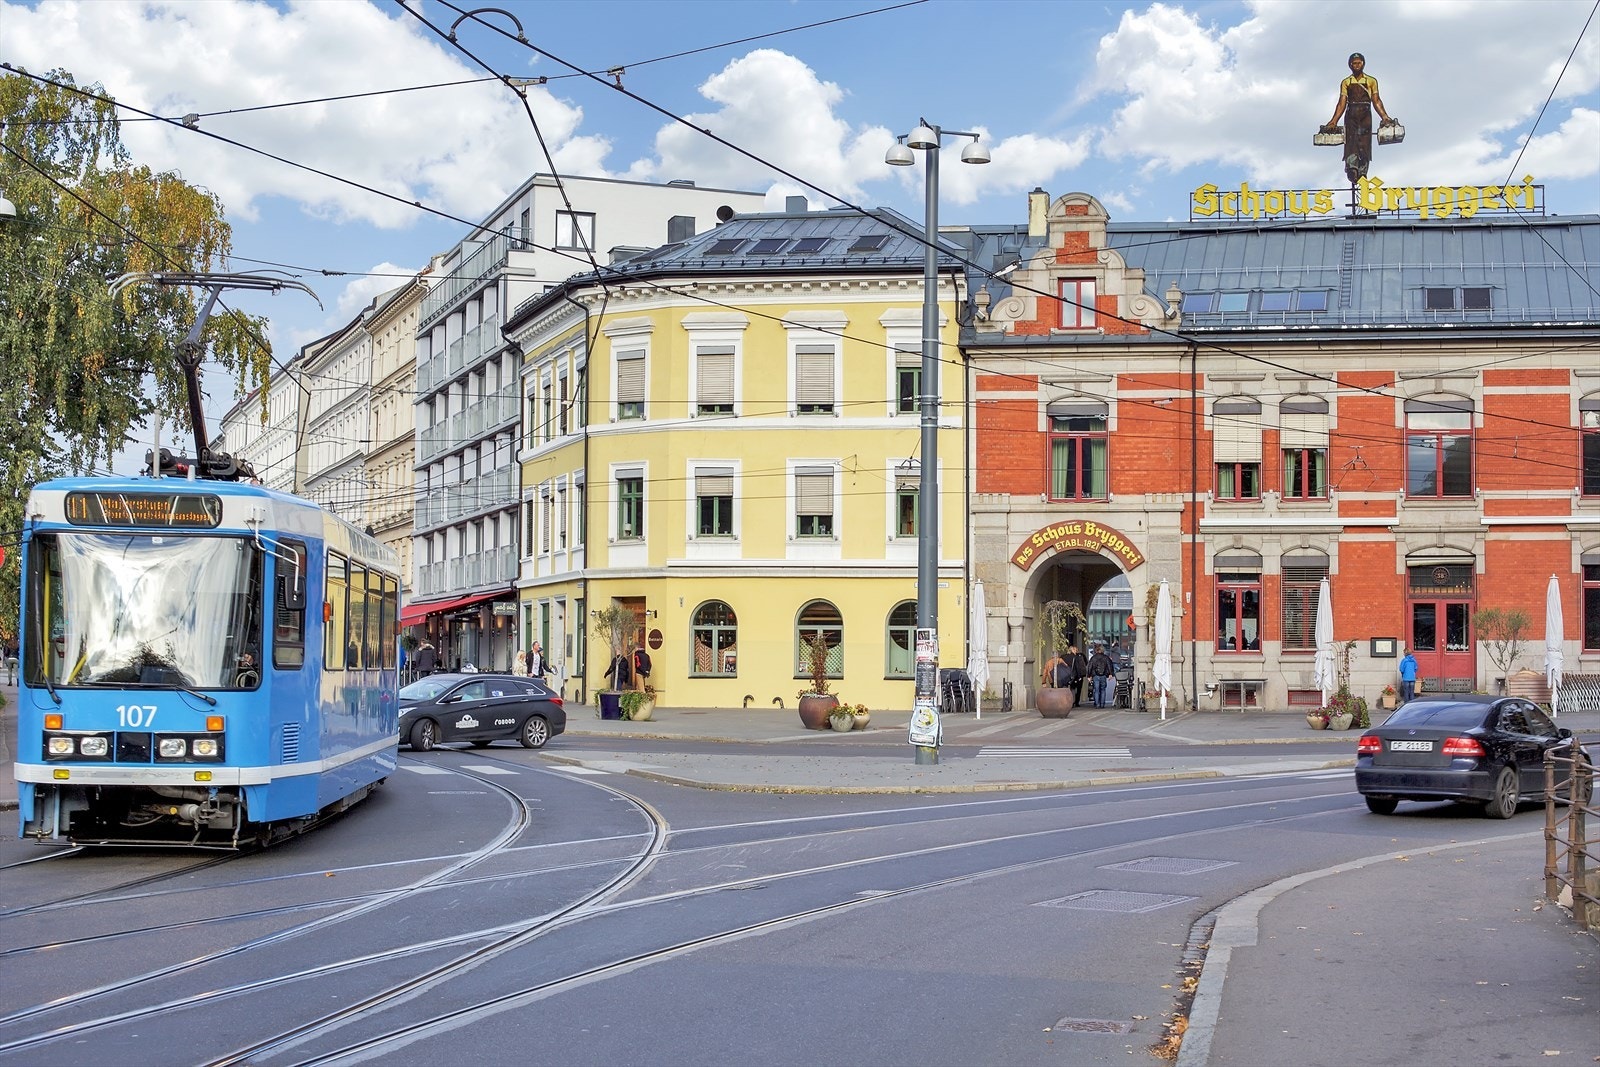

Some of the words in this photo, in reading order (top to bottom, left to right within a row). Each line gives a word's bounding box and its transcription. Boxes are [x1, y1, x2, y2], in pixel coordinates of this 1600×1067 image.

[1193, 181, 1335, 220] Schous
[1356, 174, 1536, 220] Bryggeri
[71, 496, 87, 519] 11
[1016, 546, 1034, 566] A/S
[1031, 523, 1082, 548] Schous
[1084, 521, 1141, 565] Bryggeri
[116, 705, 157, 727] 107
